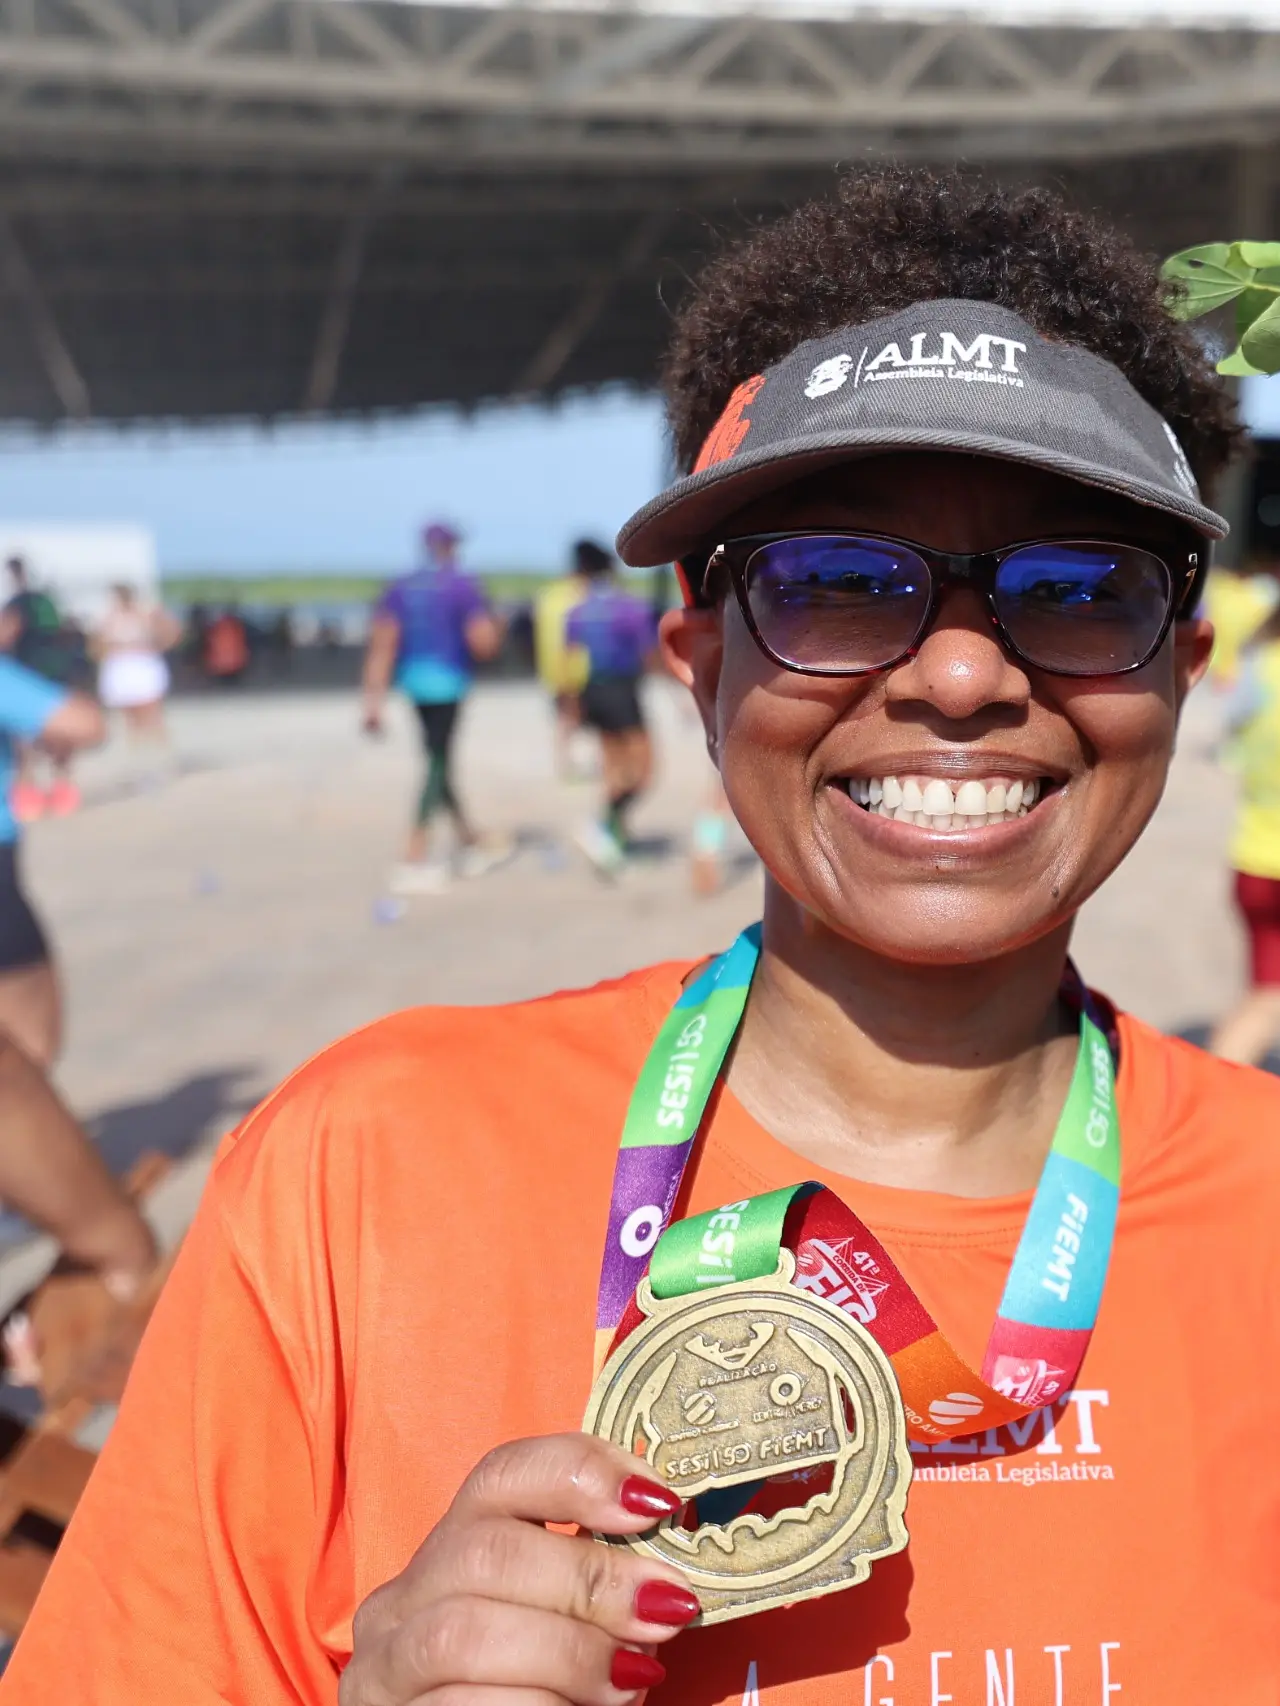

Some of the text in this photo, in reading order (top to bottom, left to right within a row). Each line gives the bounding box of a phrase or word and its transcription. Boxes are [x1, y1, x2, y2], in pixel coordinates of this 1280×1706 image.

[865, 332, 1027, 373] ALMT
[864, 366, 1024, 388] Assembleia Legislativa
[913, 1459, 1115, 1486] mbleia Legislativa
